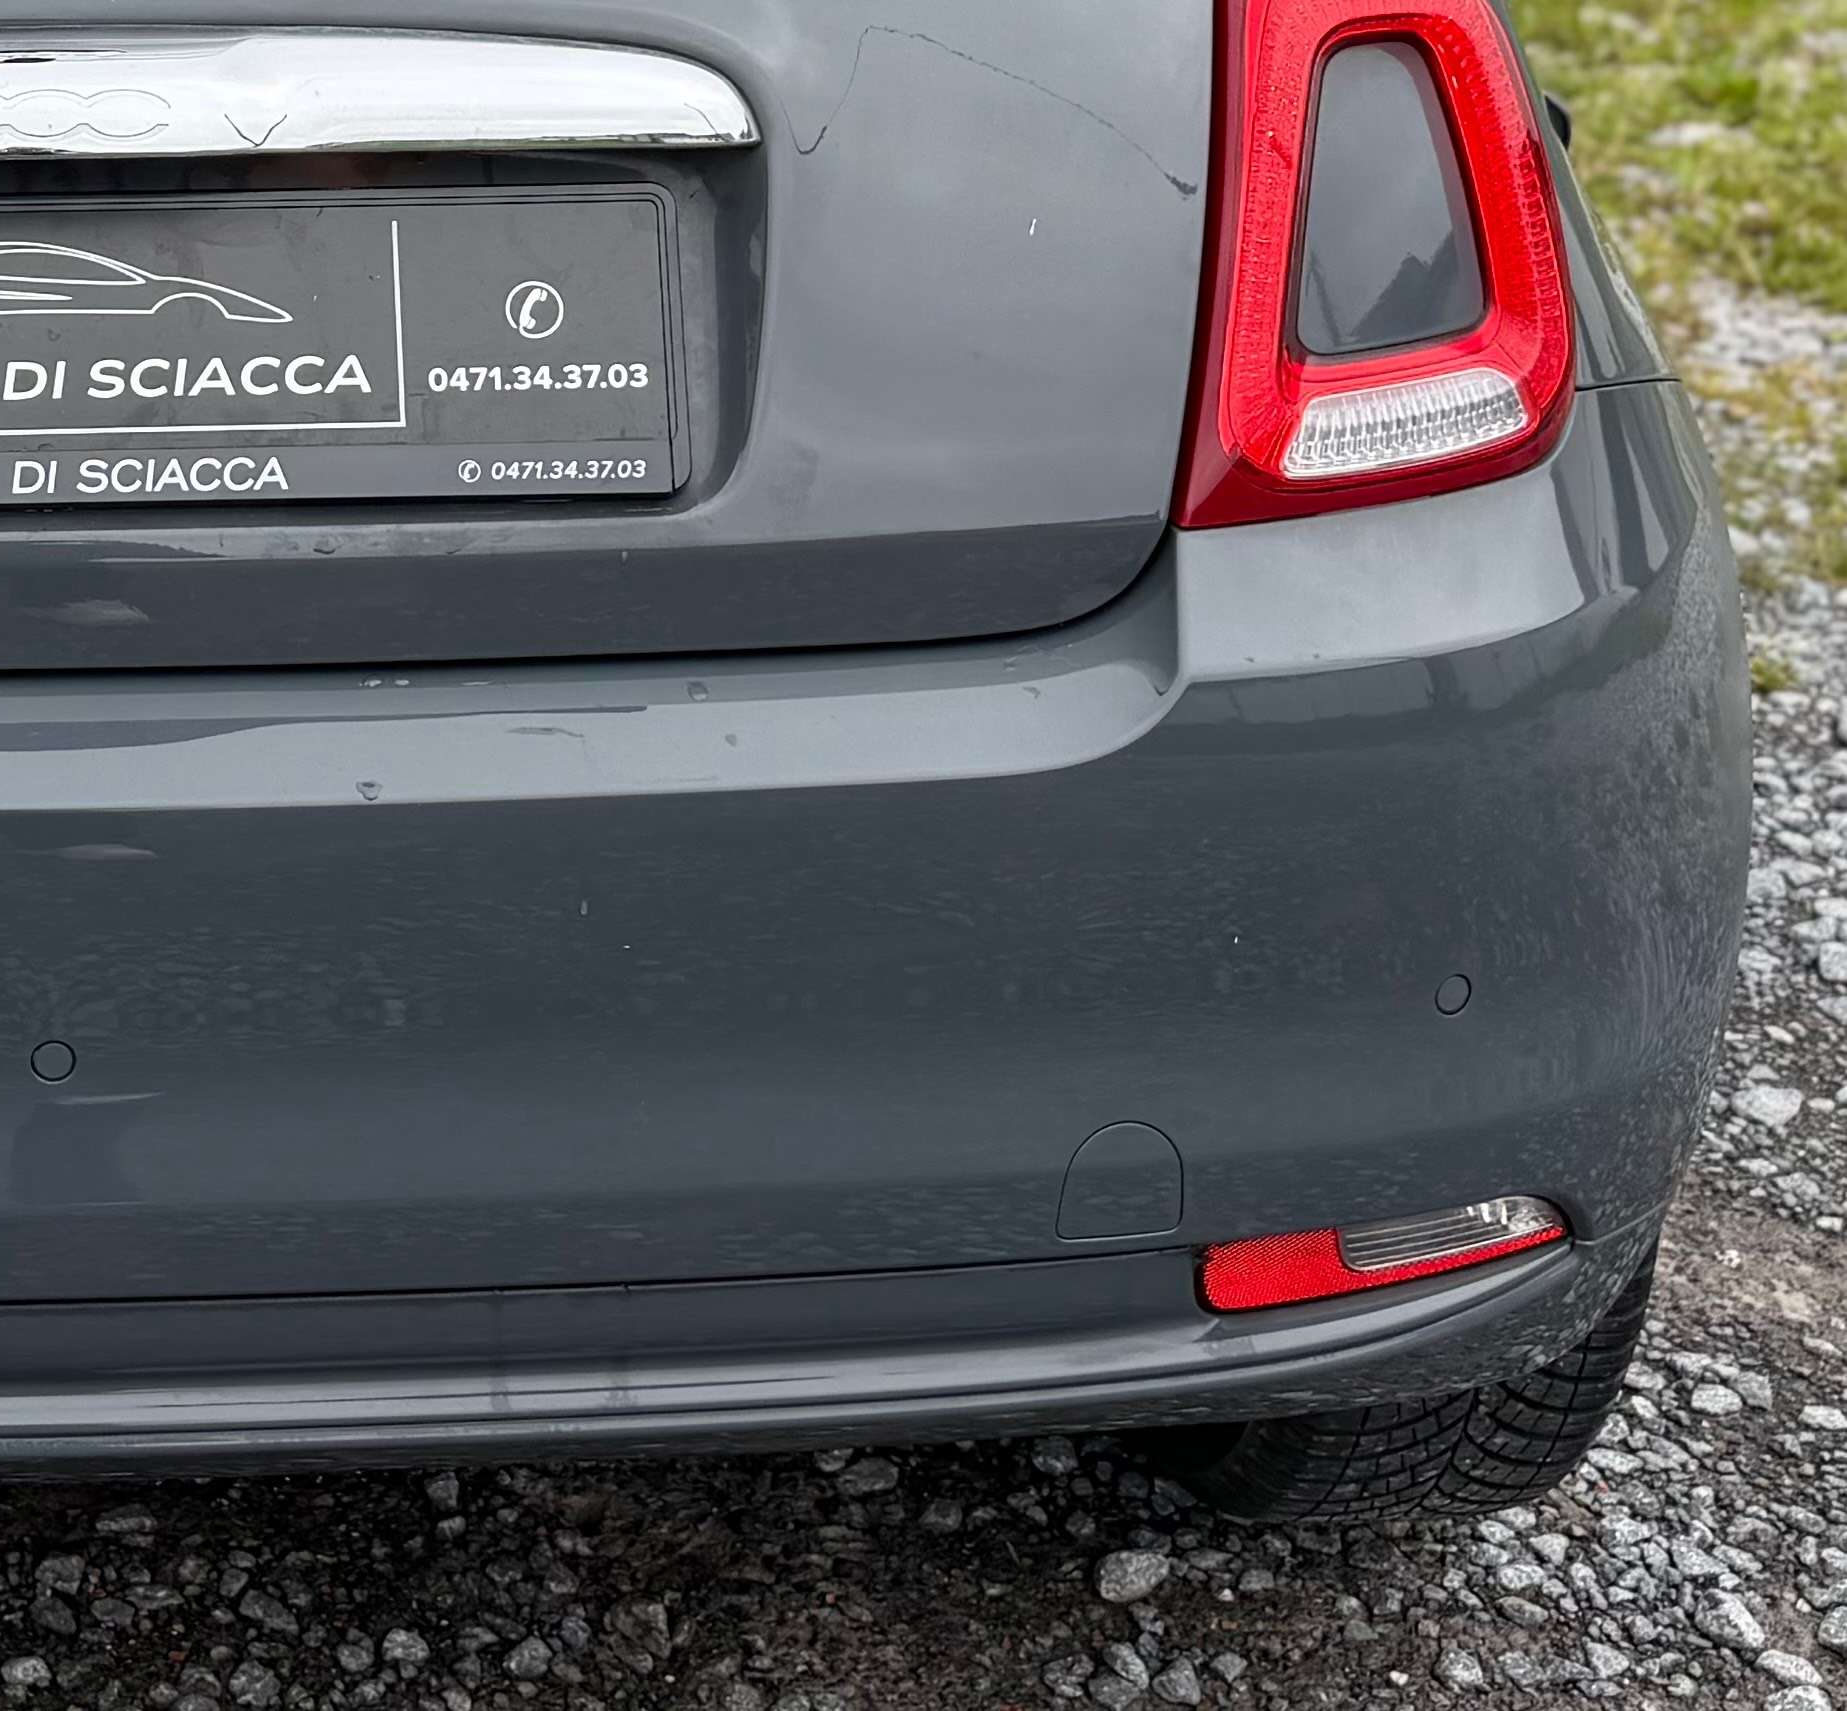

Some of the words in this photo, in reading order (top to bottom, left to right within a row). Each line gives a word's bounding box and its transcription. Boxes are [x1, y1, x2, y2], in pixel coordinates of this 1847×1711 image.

[2, 360, 67, 402] DI
[87, 354, 372, 399] SCIACCA
[427, 363, 649, 393] 0471.34.37.03
[11, 460, 58, 495] DI
[76, 456, 290, 494] SCIACCA
[490, 459, 648, 481] 0471.34.37.03
